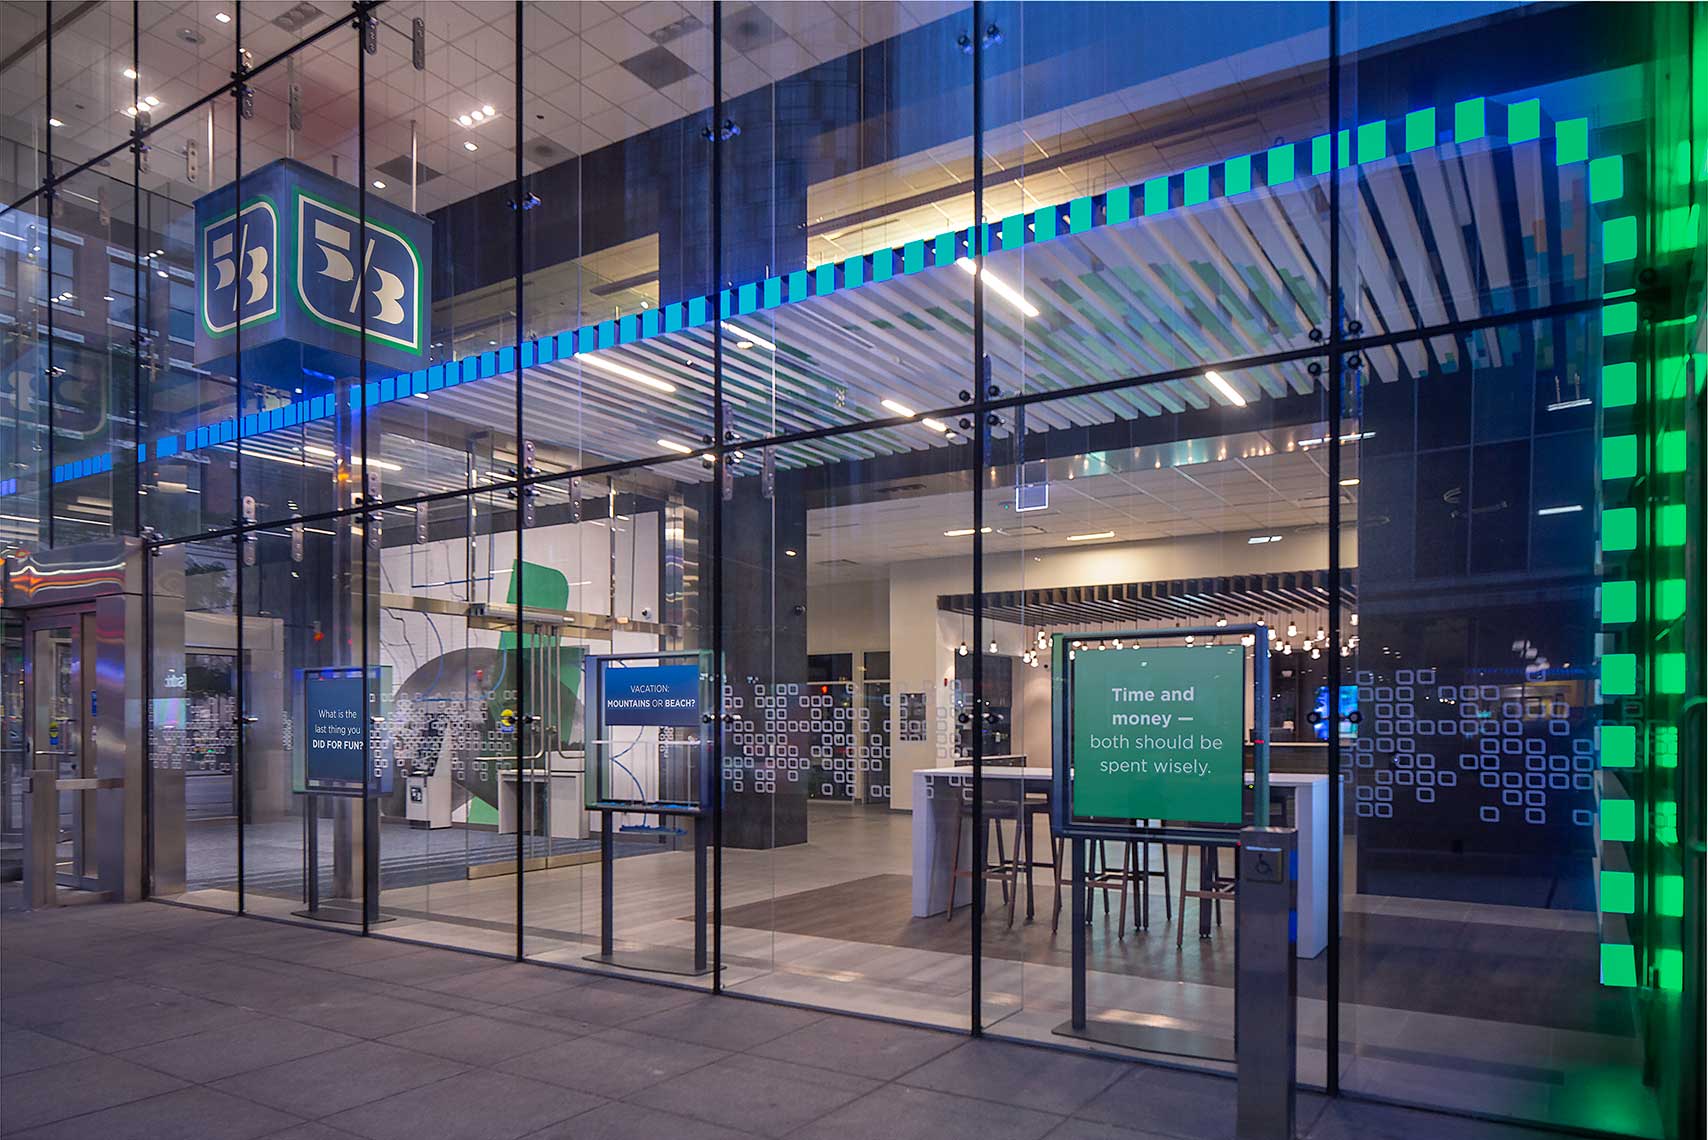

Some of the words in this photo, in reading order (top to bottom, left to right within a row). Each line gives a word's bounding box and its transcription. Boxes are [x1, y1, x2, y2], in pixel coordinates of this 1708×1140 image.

[315, 219, 405, 324] 5/3
[630, 684, 670, 693] VACATION:
[1111, 687, 1155, 702] Time
[1160, 686, 1195, 702] and
[607, 699, 650, 708] MOUNTAINS
[651, 699, 663, 708] OR
[664, 699, 696, 708] BEACH?
[318, 709, 337, 719] What
[338, 709, 344, 719] is
[345, 709, 357, 719] the
[1112, 713, 1172, 728] money
[314, 723, 327, 734] last
[328, 724, 346, 736] thing
[347, 727, 361, 736] you
[312, 739, 326, 749] DID
[326, 740, 343, 750] FOR
[343, 740, 364, 750] FUN?
[1090, 734, 1130, 749] both
[1135, 734, 1194, 750] should
[1200, 734, 1223, 750] be
[1100, 759, 1148, 775] spent
[1153, 758, 1212, 777] wisely.
